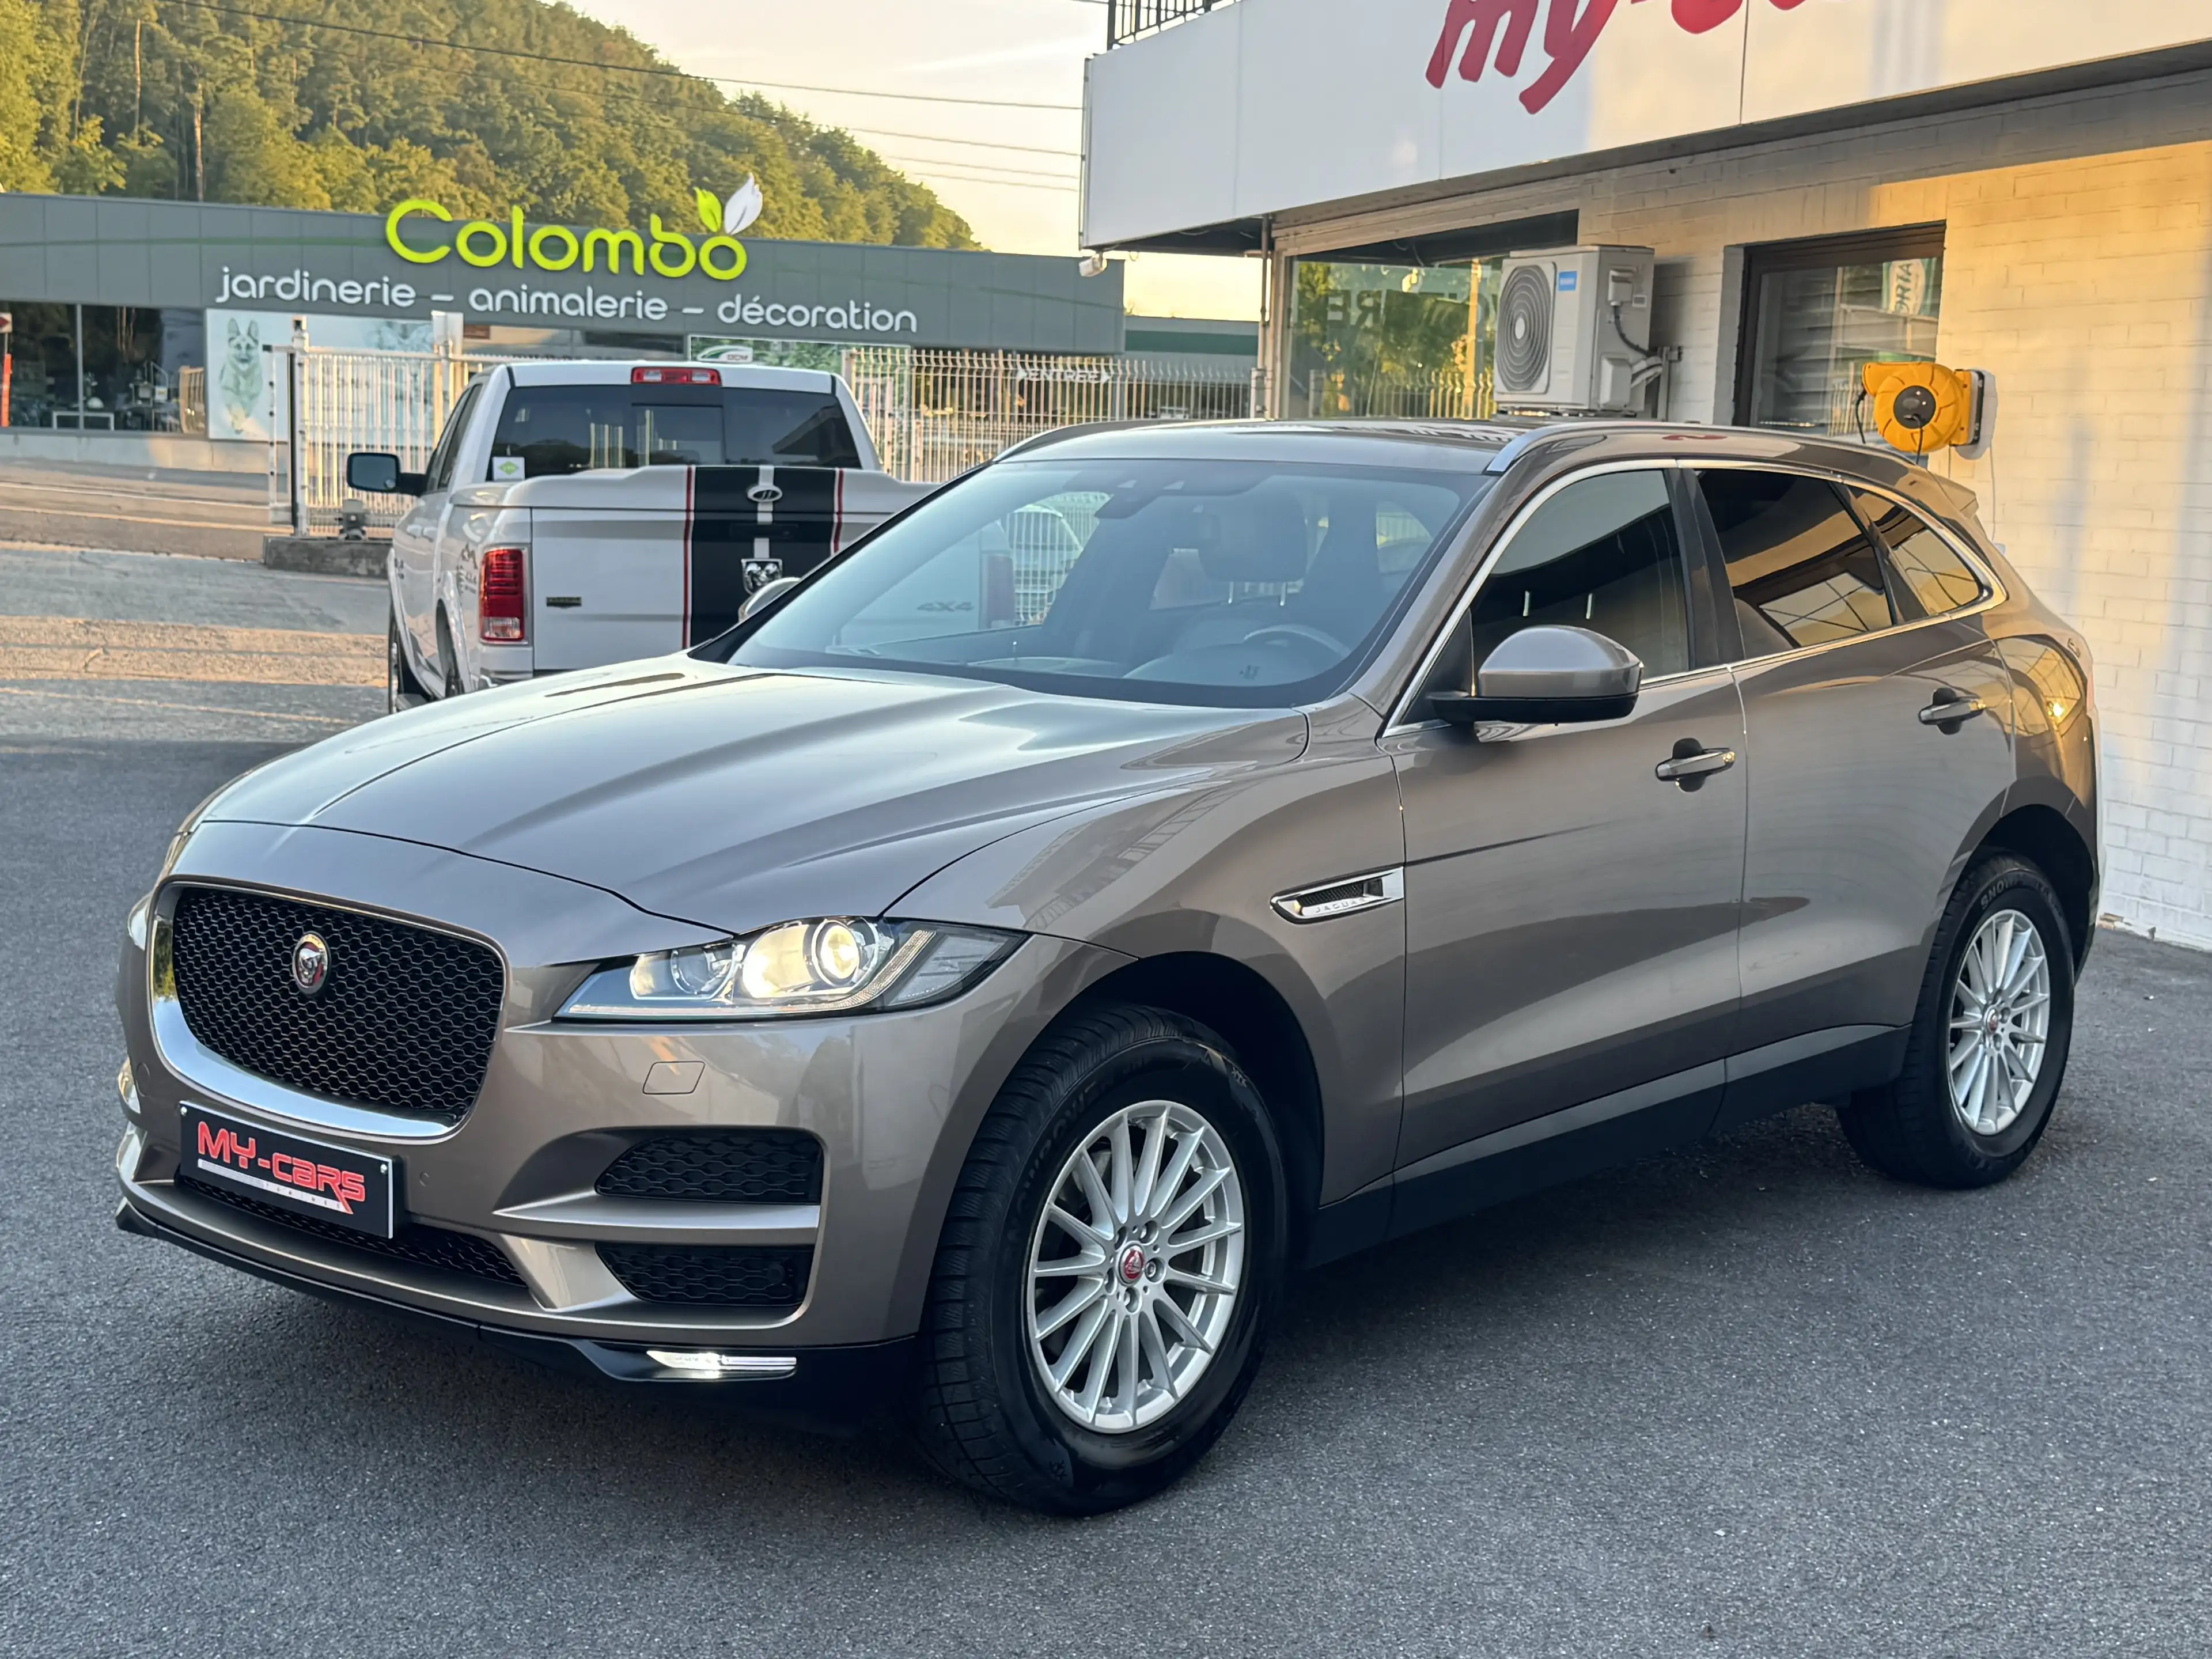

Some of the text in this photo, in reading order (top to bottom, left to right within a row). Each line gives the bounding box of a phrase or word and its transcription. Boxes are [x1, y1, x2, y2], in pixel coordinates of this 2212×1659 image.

[386, 199, 747, 281] Colombo
[215, 267, 416, 307] jardinerie
[469, 284, 668, 320] animalerie
[717, 293, 917, 333] décoration
[1315, 897, 1367, 914] JAGUAR
